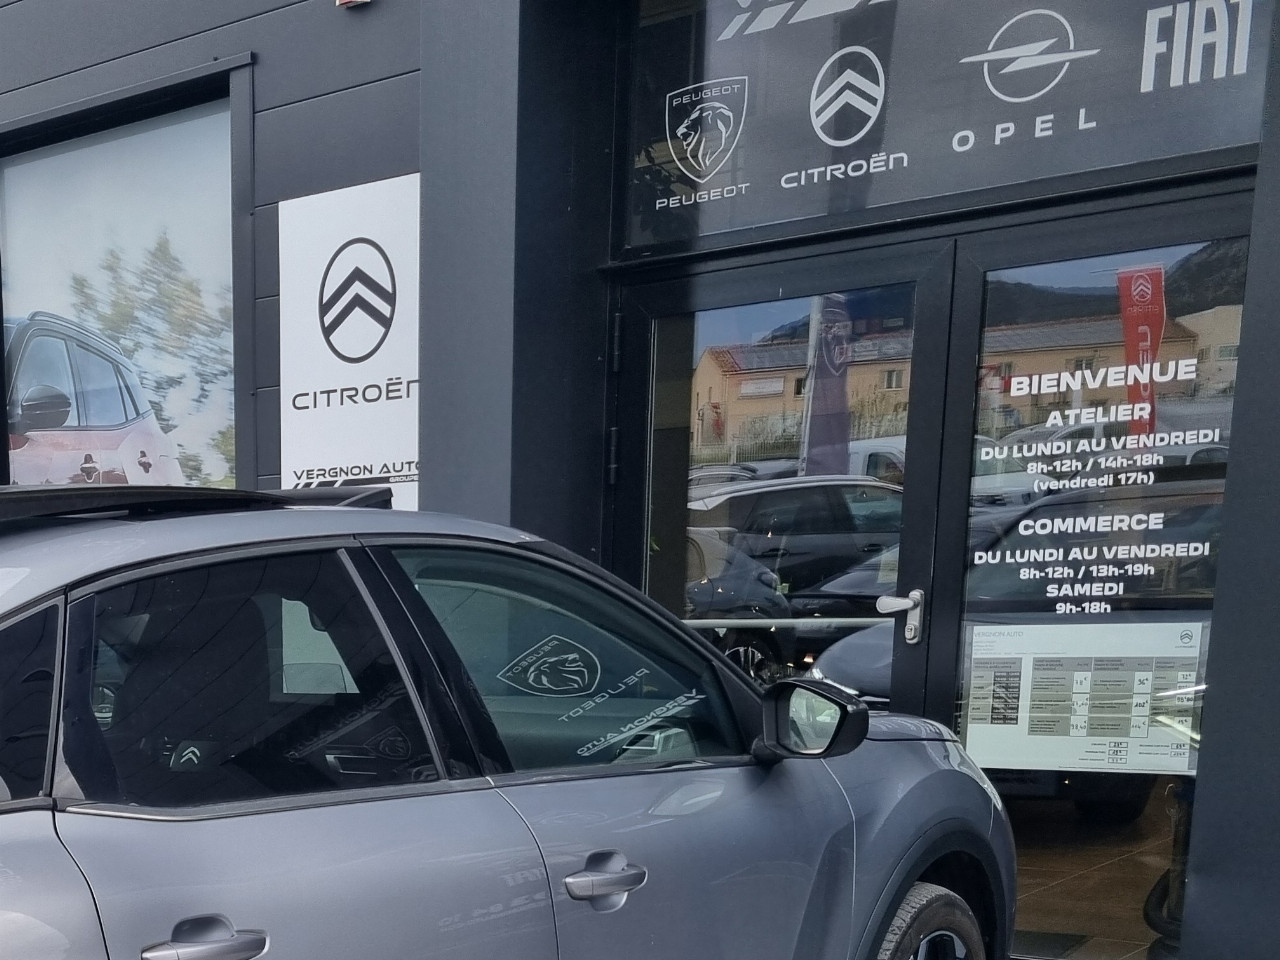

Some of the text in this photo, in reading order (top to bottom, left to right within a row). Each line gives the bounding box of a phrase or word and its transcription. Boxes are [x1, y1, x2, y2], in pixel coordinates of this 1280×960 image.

[1140, 0, 1253, 93] FIAT
[672, 84, 741, 107] PEUGEOT
[952, 108, 1098, 153] OPEL
[780, 151, 909, 189] CITROËN
[655, 182, 751, 211] PEUGEOT
[1009, 358, 1198, 397] BIENVENUE
[1045, 402, 1151, 428] ATELIER
[980, 428, 1220, 461] DU LUNDI AU VENDREDI
[293, 464, 373, 480] VERGNON
[1026, 459, 1082, 474] 8h-12h
[1097, 453, 1164, 469] 14h-18h
[1032, 471, 1155, 493] (vendredi 17h)
[1018, 513, 1165, 536] COMMERCE
[973, 542, 1211, 565] DU LUNDI AU VENDREDI
[1019, 566, 1075, 580] 8h-12h
[1089, 563, 1155, 577] 13h-19h
[1045, 583, 1124, 597] SAMEDI
[1055, 601, 1112, 614] 9h-18h
